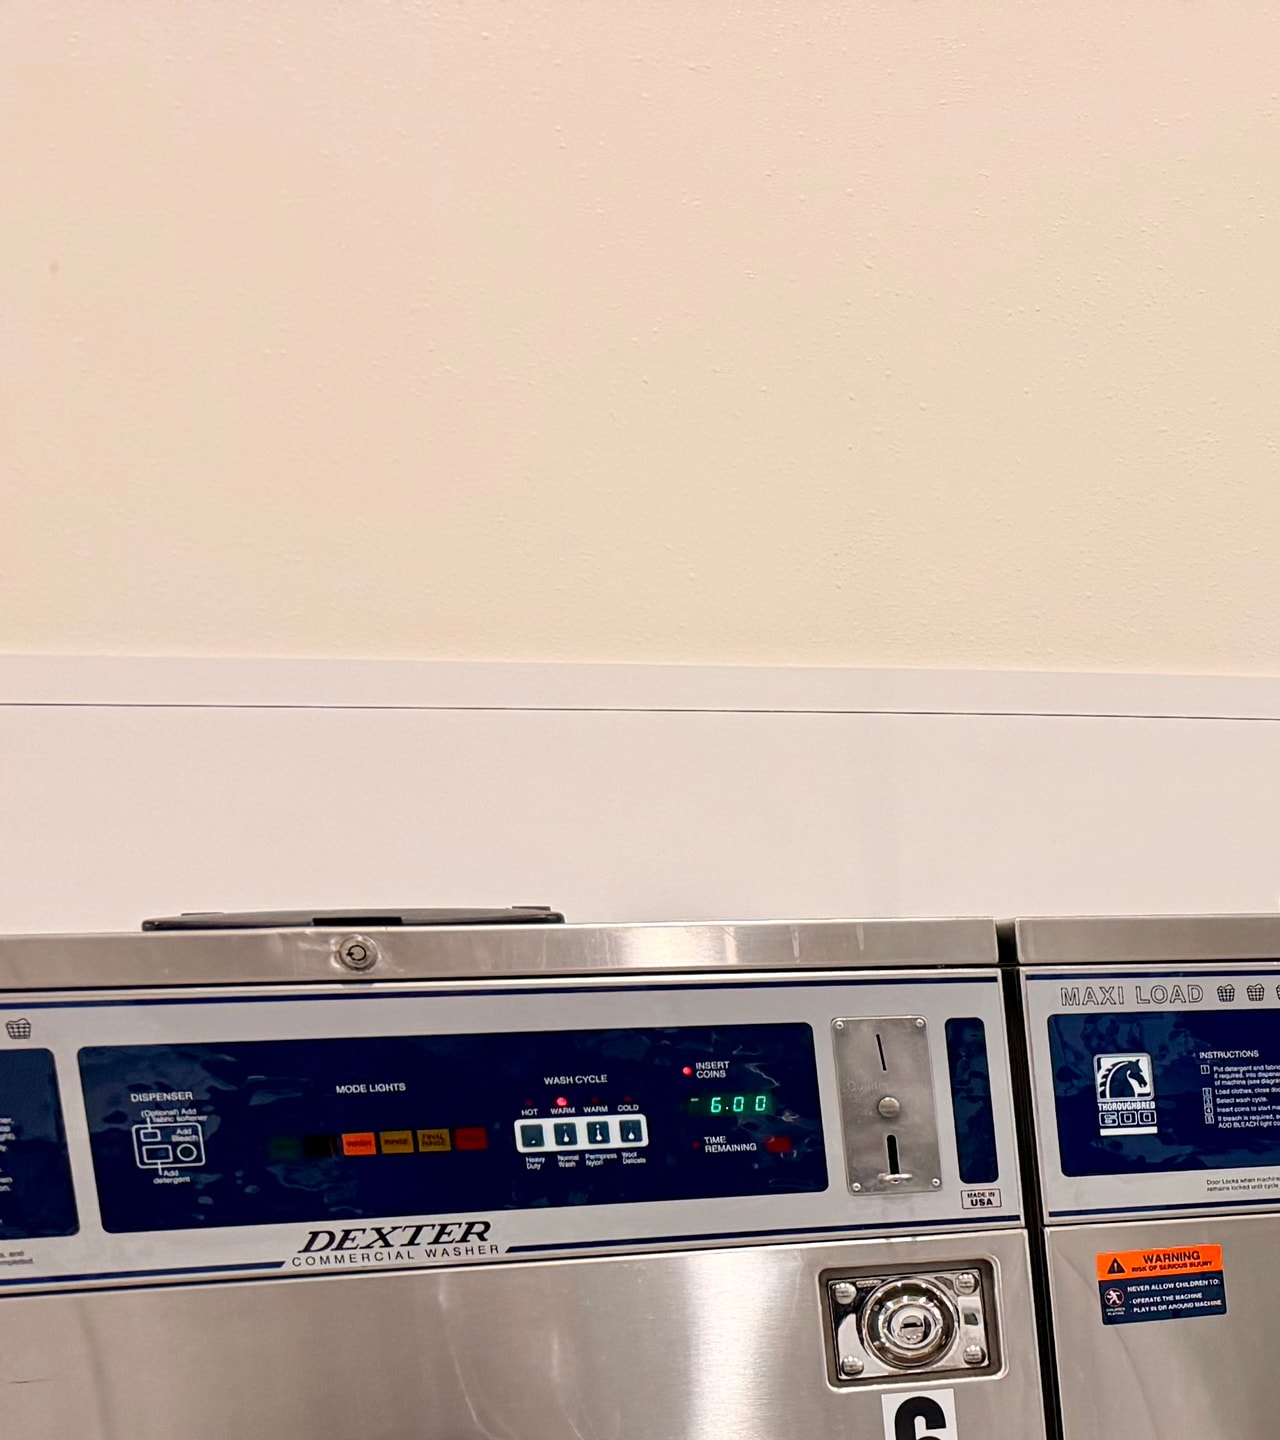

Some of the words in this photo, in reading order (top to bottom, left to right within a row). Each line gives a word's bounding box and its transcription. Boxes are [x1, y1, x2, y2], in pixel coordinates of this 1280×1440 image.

[1061, 986, 1124, 1006] MAXI
[1136, 985, 1203, 1005] LOAD
[1200, 1050, 1259, 1058] INSTRUCTIONS
[696, 1061, 730, 1070] INSERT
[696, 1069, 726, 1078] COINS
[544, 1077, 573, 1085] WASH
[575, 1074, 607, 1084] CYCLE
[336, 1085, 367, 1094] MODE
[370, 1083, 406, 1092] LIGHTS
[131, 1091, 193, 1102] DISPENSER
[551, 1107, 575, 1115] WARM
[618, 1104, 639, 1112] COLD
[1098, 1101, 1155, 1111] THOROUGHBRED
[704, 1136, 726, 1144] TIME
[704, 1143, 757, 1153] REMAINING
[526, 1163, 541, 1171] Duty
[297, 1221, 492, 1253] DEXTER
[292, 1251, 415, 1267] COMMERCIAL
[425, 1245, 498, 1258] WASHER
[1143, 1251, 1201, 1264] WARNING
[1176, 1280, 1208, 1288] CHILDREN
[1133, 1296, 1161, 1304] OPERATE
[1195, 1300, 1222, 1308] MACHINE
